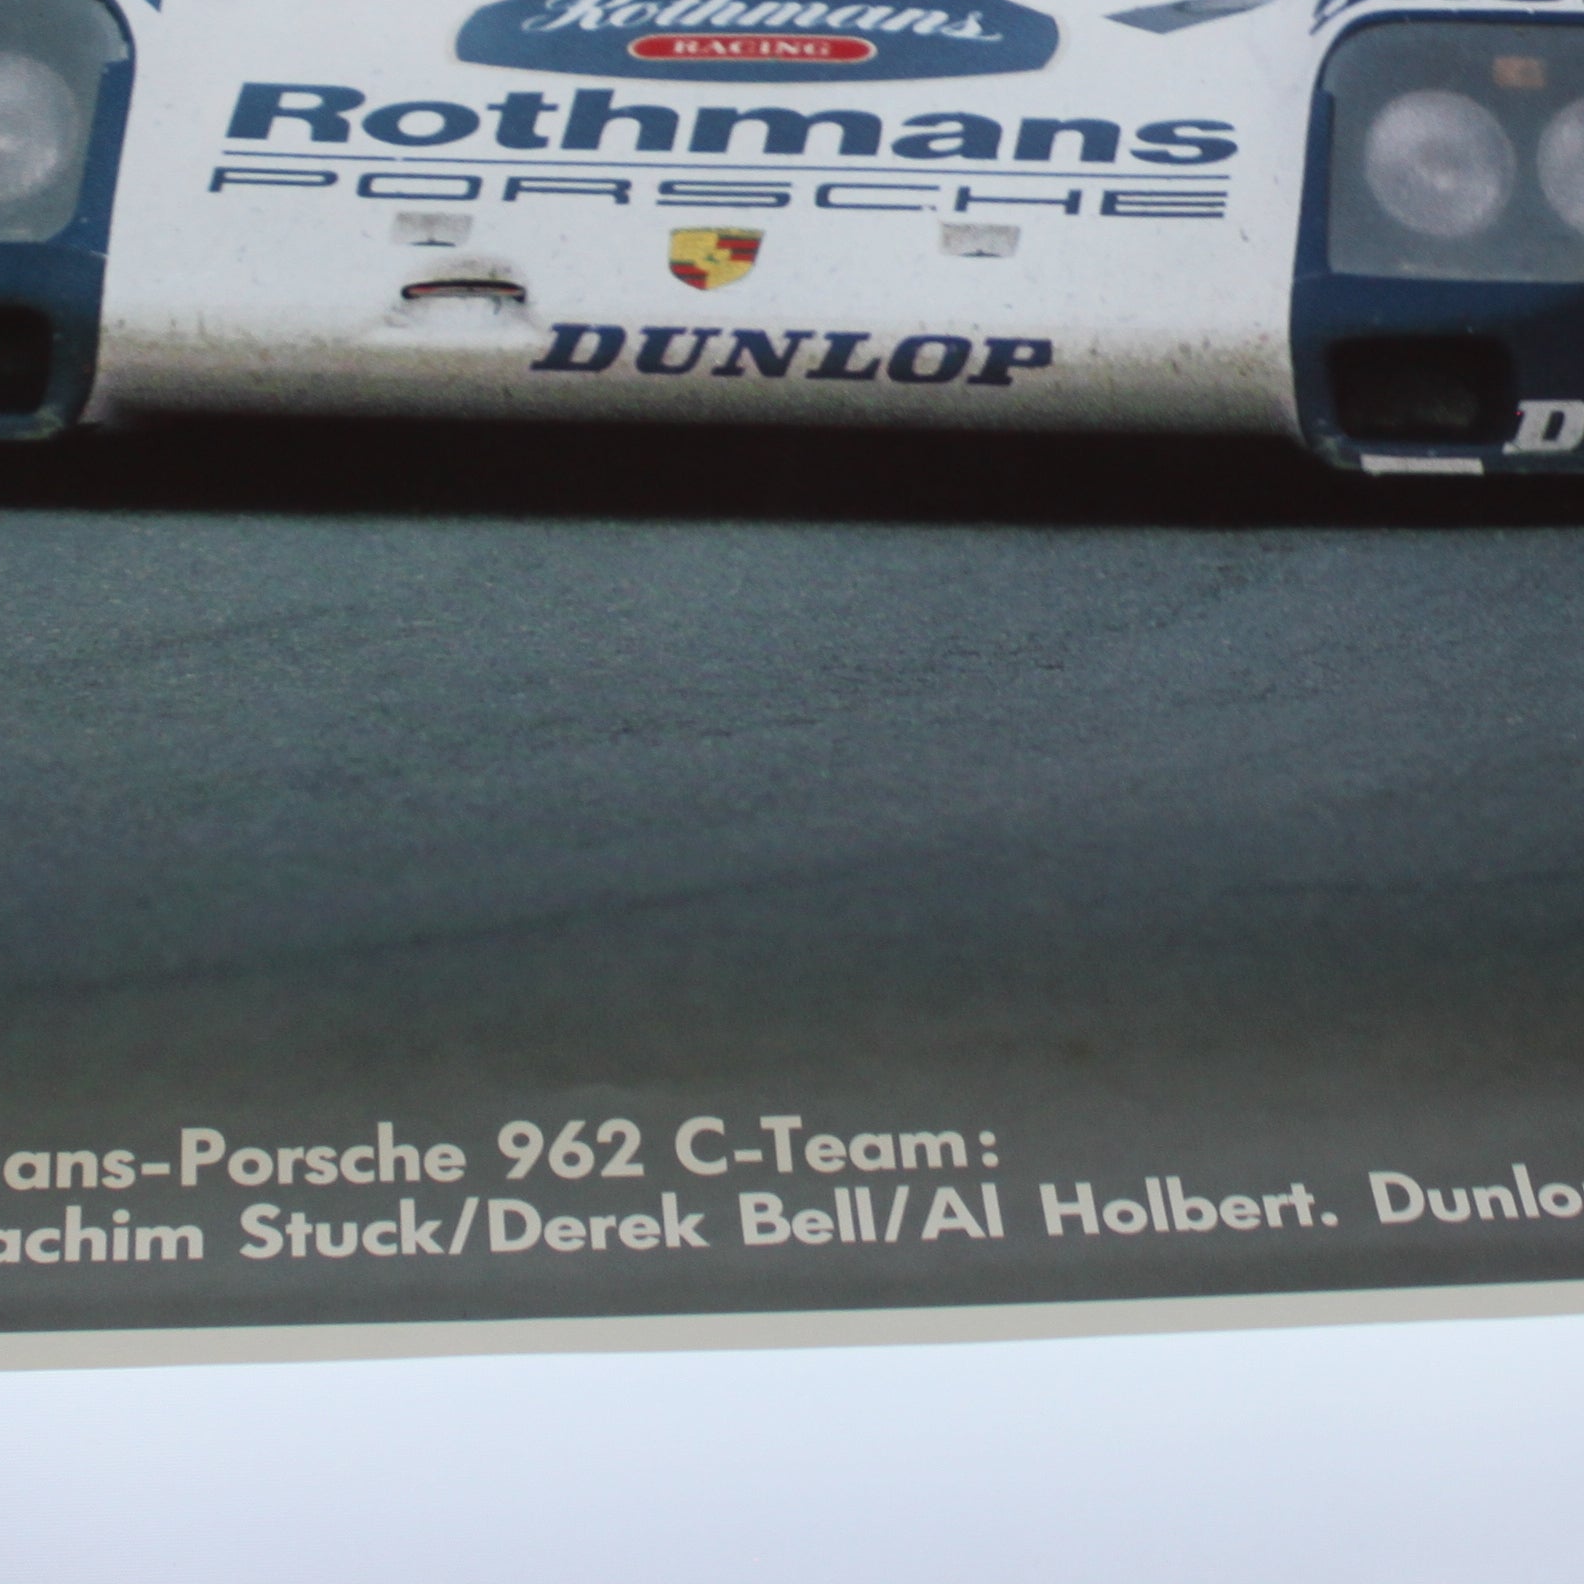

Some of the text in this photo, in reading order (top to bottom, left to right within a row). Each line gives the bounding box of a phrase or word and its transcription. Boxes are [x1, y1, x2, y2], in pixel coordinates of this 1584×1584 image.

[672, 38, 833, 57] RACING
[224, 81, 1239, 167] Rothmans
[207, 165, 1229, 219] PORSCHE
[531, 322, 1054, 387] DUNLOP
[497, 1118, 645, 1180] 962
[675, 1115, 999, 1176] C-Team:
[239, 1191, 710, 1260] Stuck/Derek
[738, 1182, 1005, 1247] Bell/Al
[1039, 1175, 1339, 1236] Holbert.
